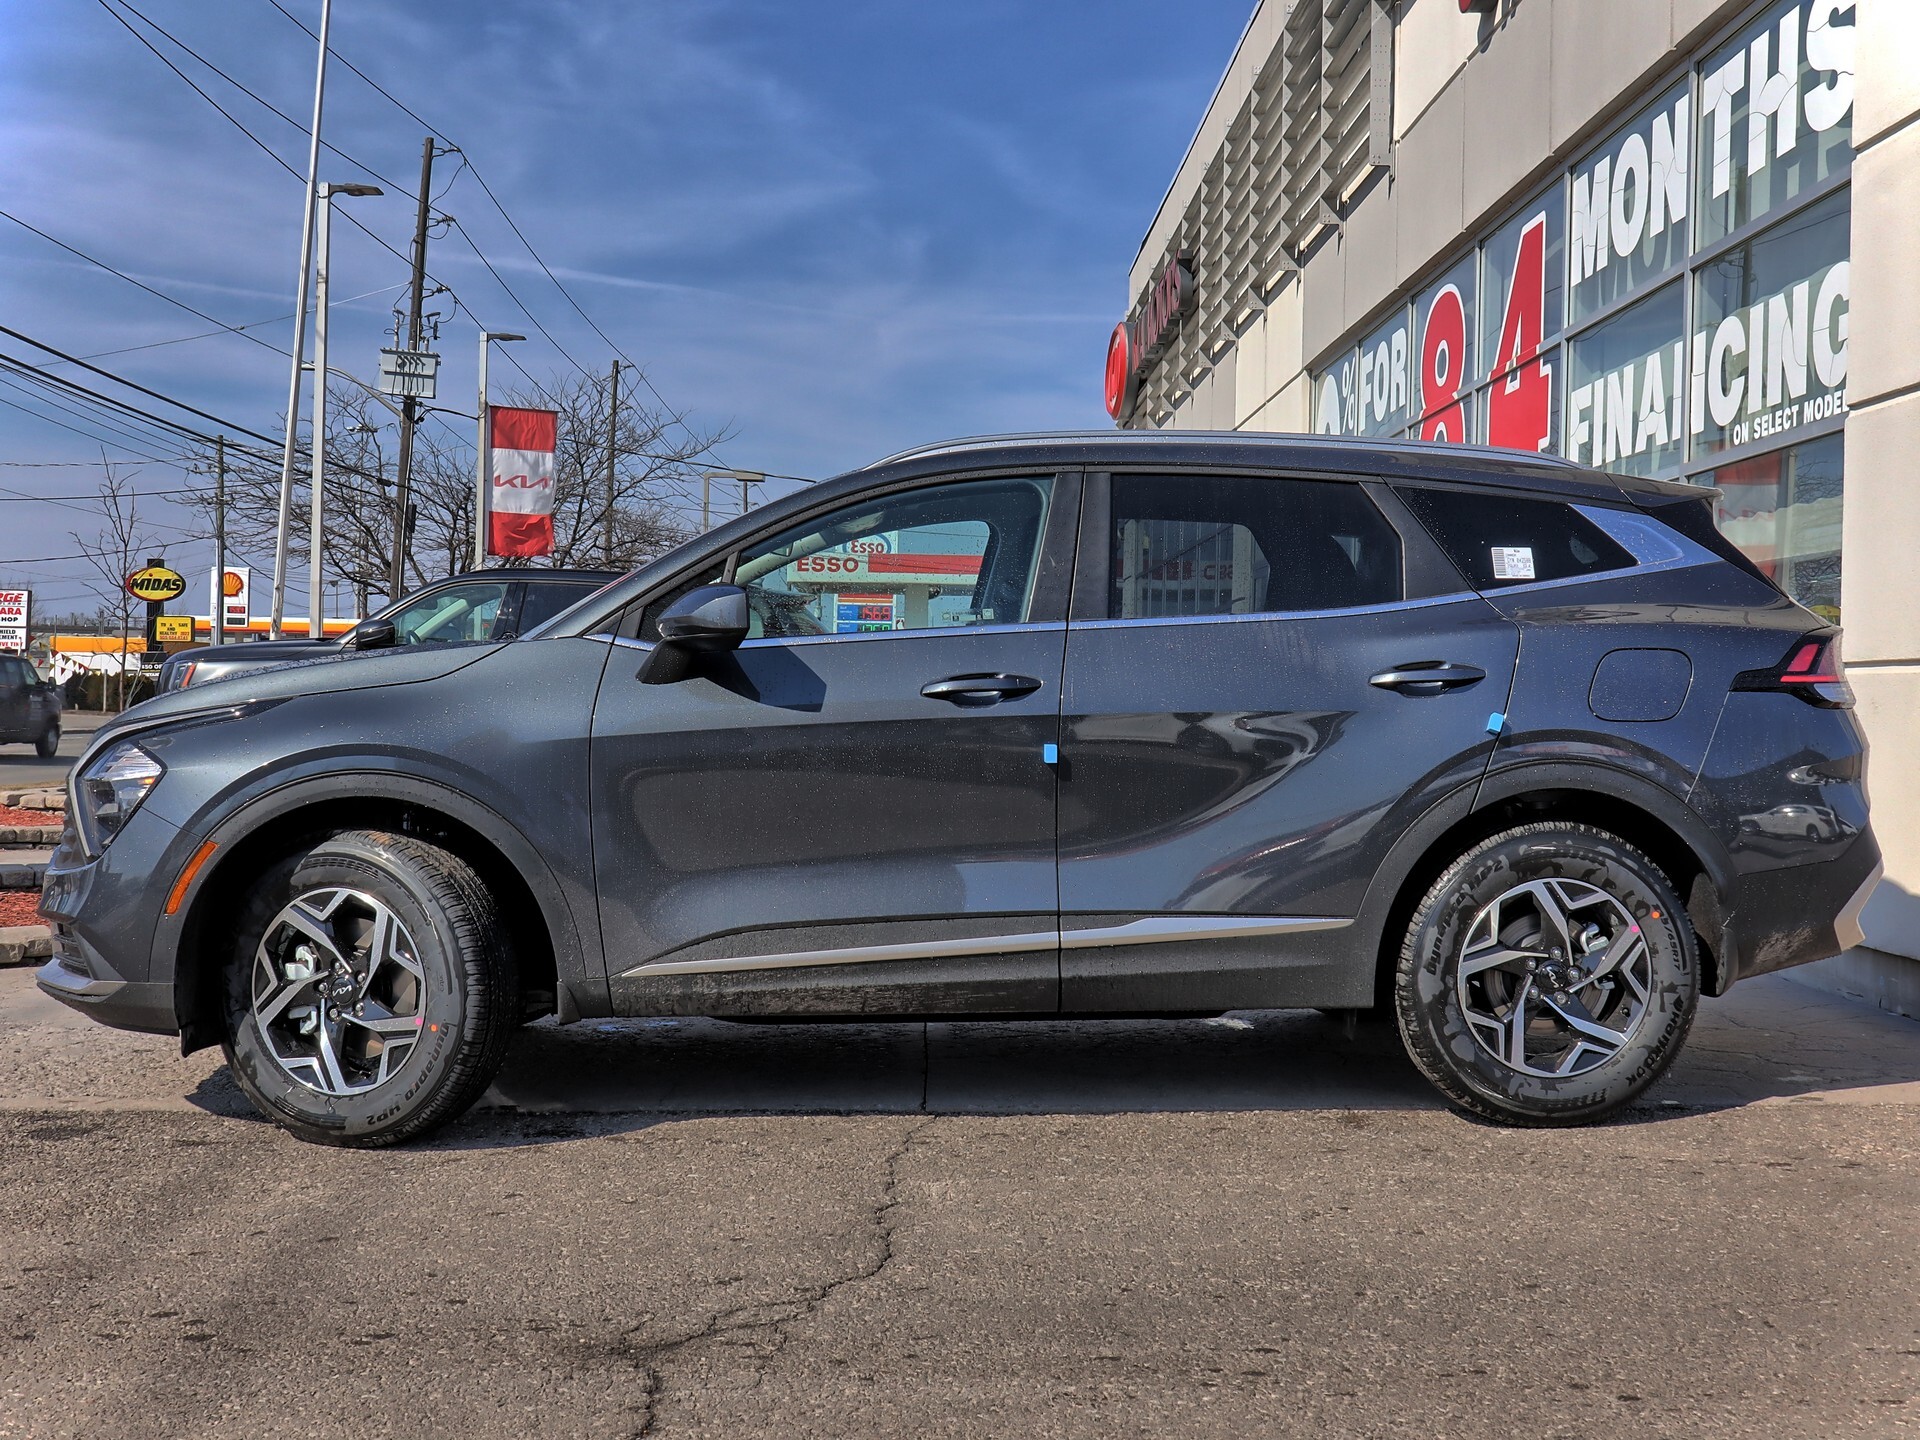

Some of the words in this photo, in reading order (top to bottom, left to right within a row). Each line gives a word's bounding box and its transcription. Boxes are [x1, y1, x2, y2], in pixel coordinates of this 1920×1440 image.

[1571, 0, 1855, 288] MONTHS
[1419, 210, 1552, 453] 84
[1360, 327, 1407, 432] FOR
[1569, 261, 1850, 467] FINANCING
[1733, 421, 1749, 446] ON
[1753, 404, 1799, 439] SELECT
[494, 474, 549, 489] KIA
[797, 556, 859, 573] ESSO
[851, 539, 884, 553] Esso
[131, 573, 181, 591] MIDAS
